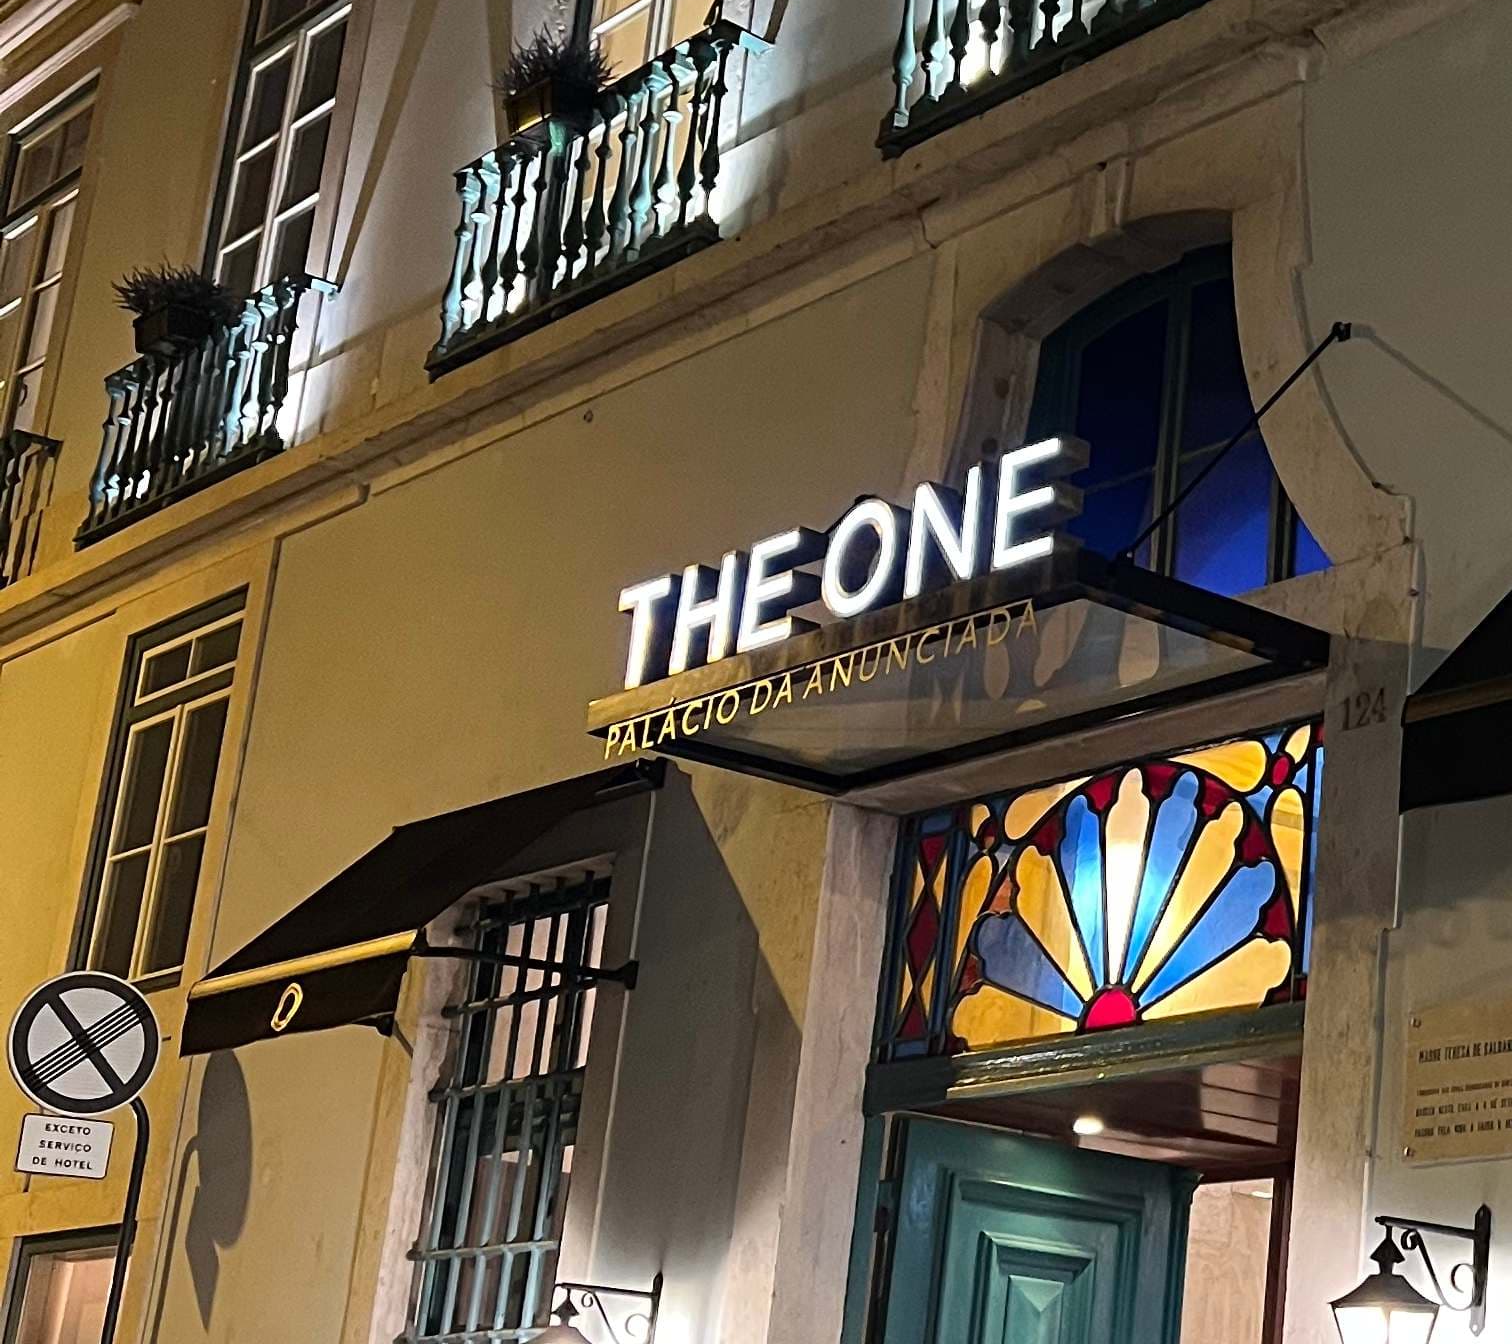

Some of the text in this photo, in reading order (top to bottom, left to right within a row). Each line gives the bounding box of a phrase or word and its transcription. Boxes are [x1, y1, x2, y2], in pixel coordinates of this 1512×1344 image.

[618, 436, 1061, 690] THE ONE
[604, 599, 1037, 760] PALÁCIO DA ANUNCIADA
[1340, 688, 1387, 732] 124
[45, 1123, 91, 1136] EXCETO
[39, 1139, 92, 1153] SERVIÇO
[32, 1156, 93, 1170] DE HOTEL
